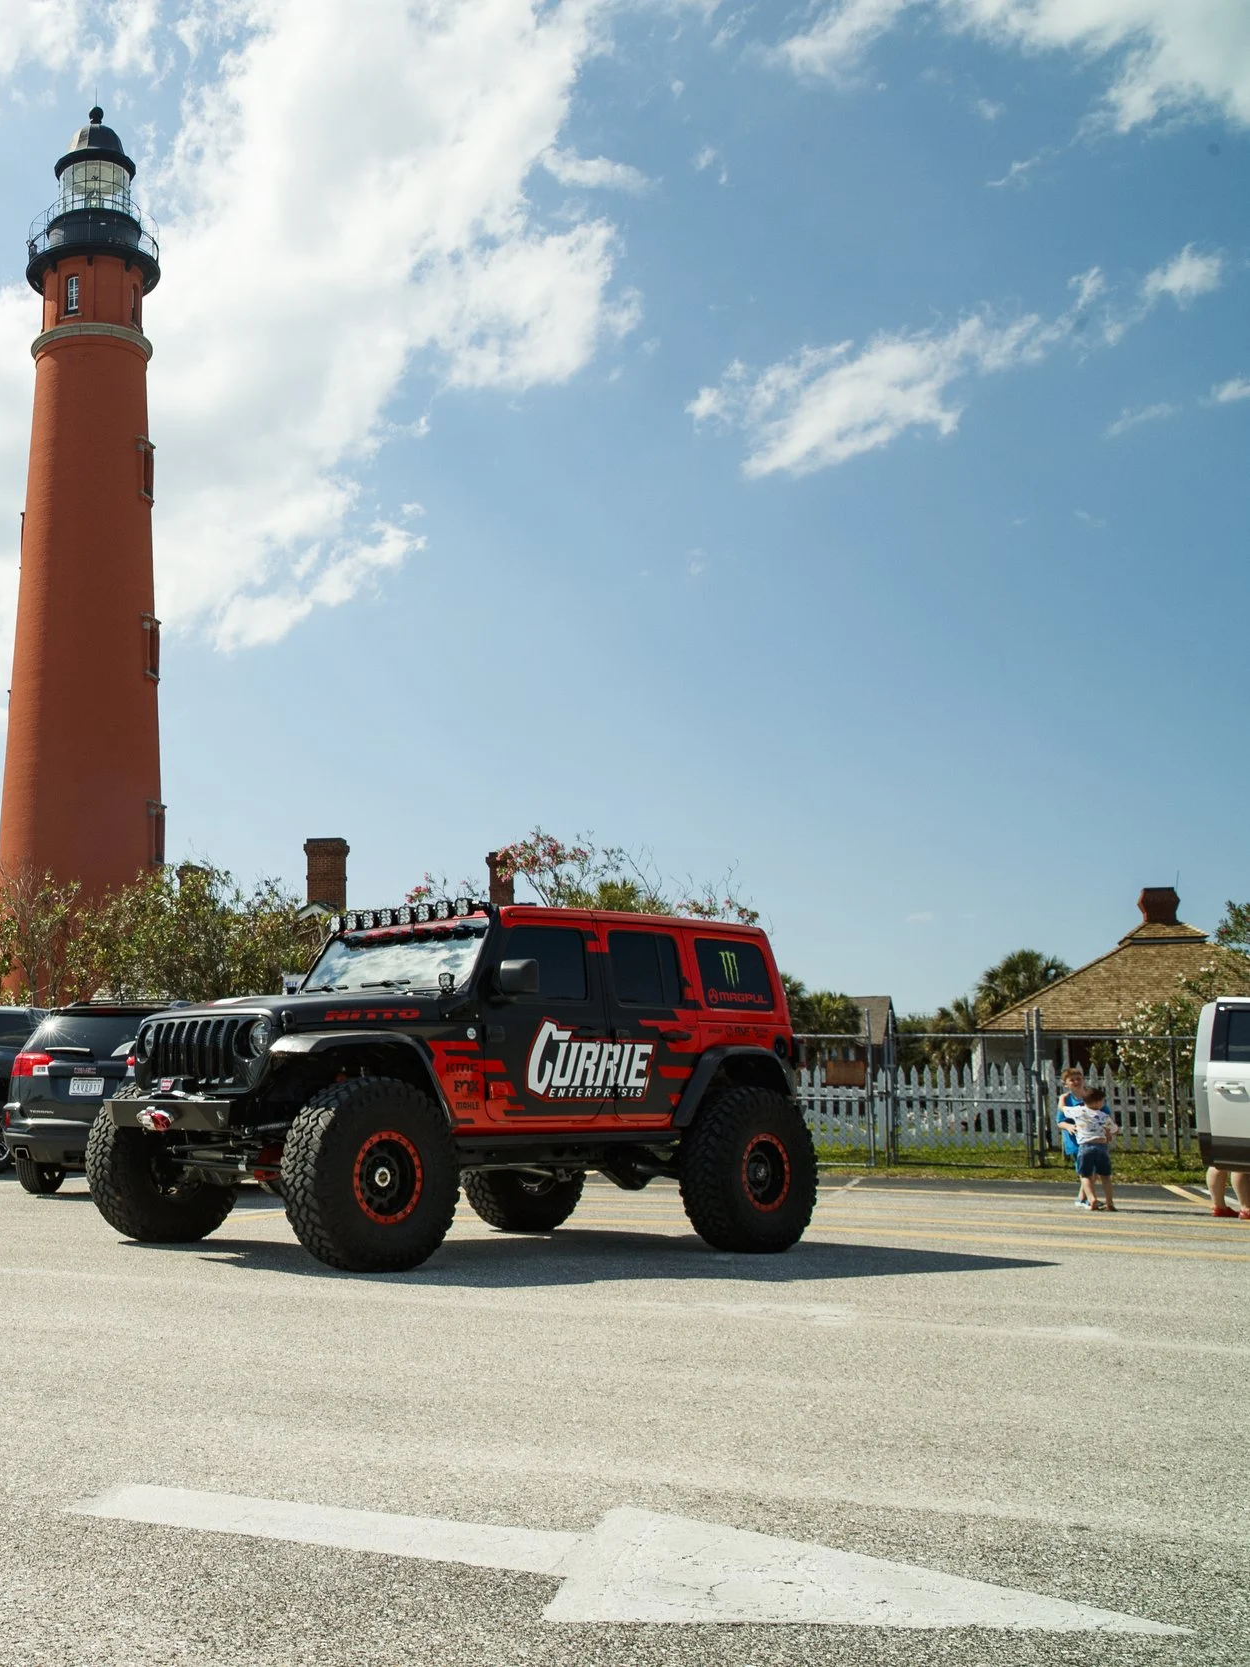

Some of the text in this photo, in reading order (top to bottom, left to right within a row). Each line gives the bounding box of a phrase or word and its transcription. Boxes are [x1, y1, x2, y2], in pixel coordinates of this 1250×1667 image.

[718, 991, 769, 1005] MAGPUL
[324, 1008, 422, 1022] NITTO
[527, 1020, 654, 1096] CURRIE
[445, 1063, 479, 1073] KMC
[455, 1101, 480, 1111] MAHLE
